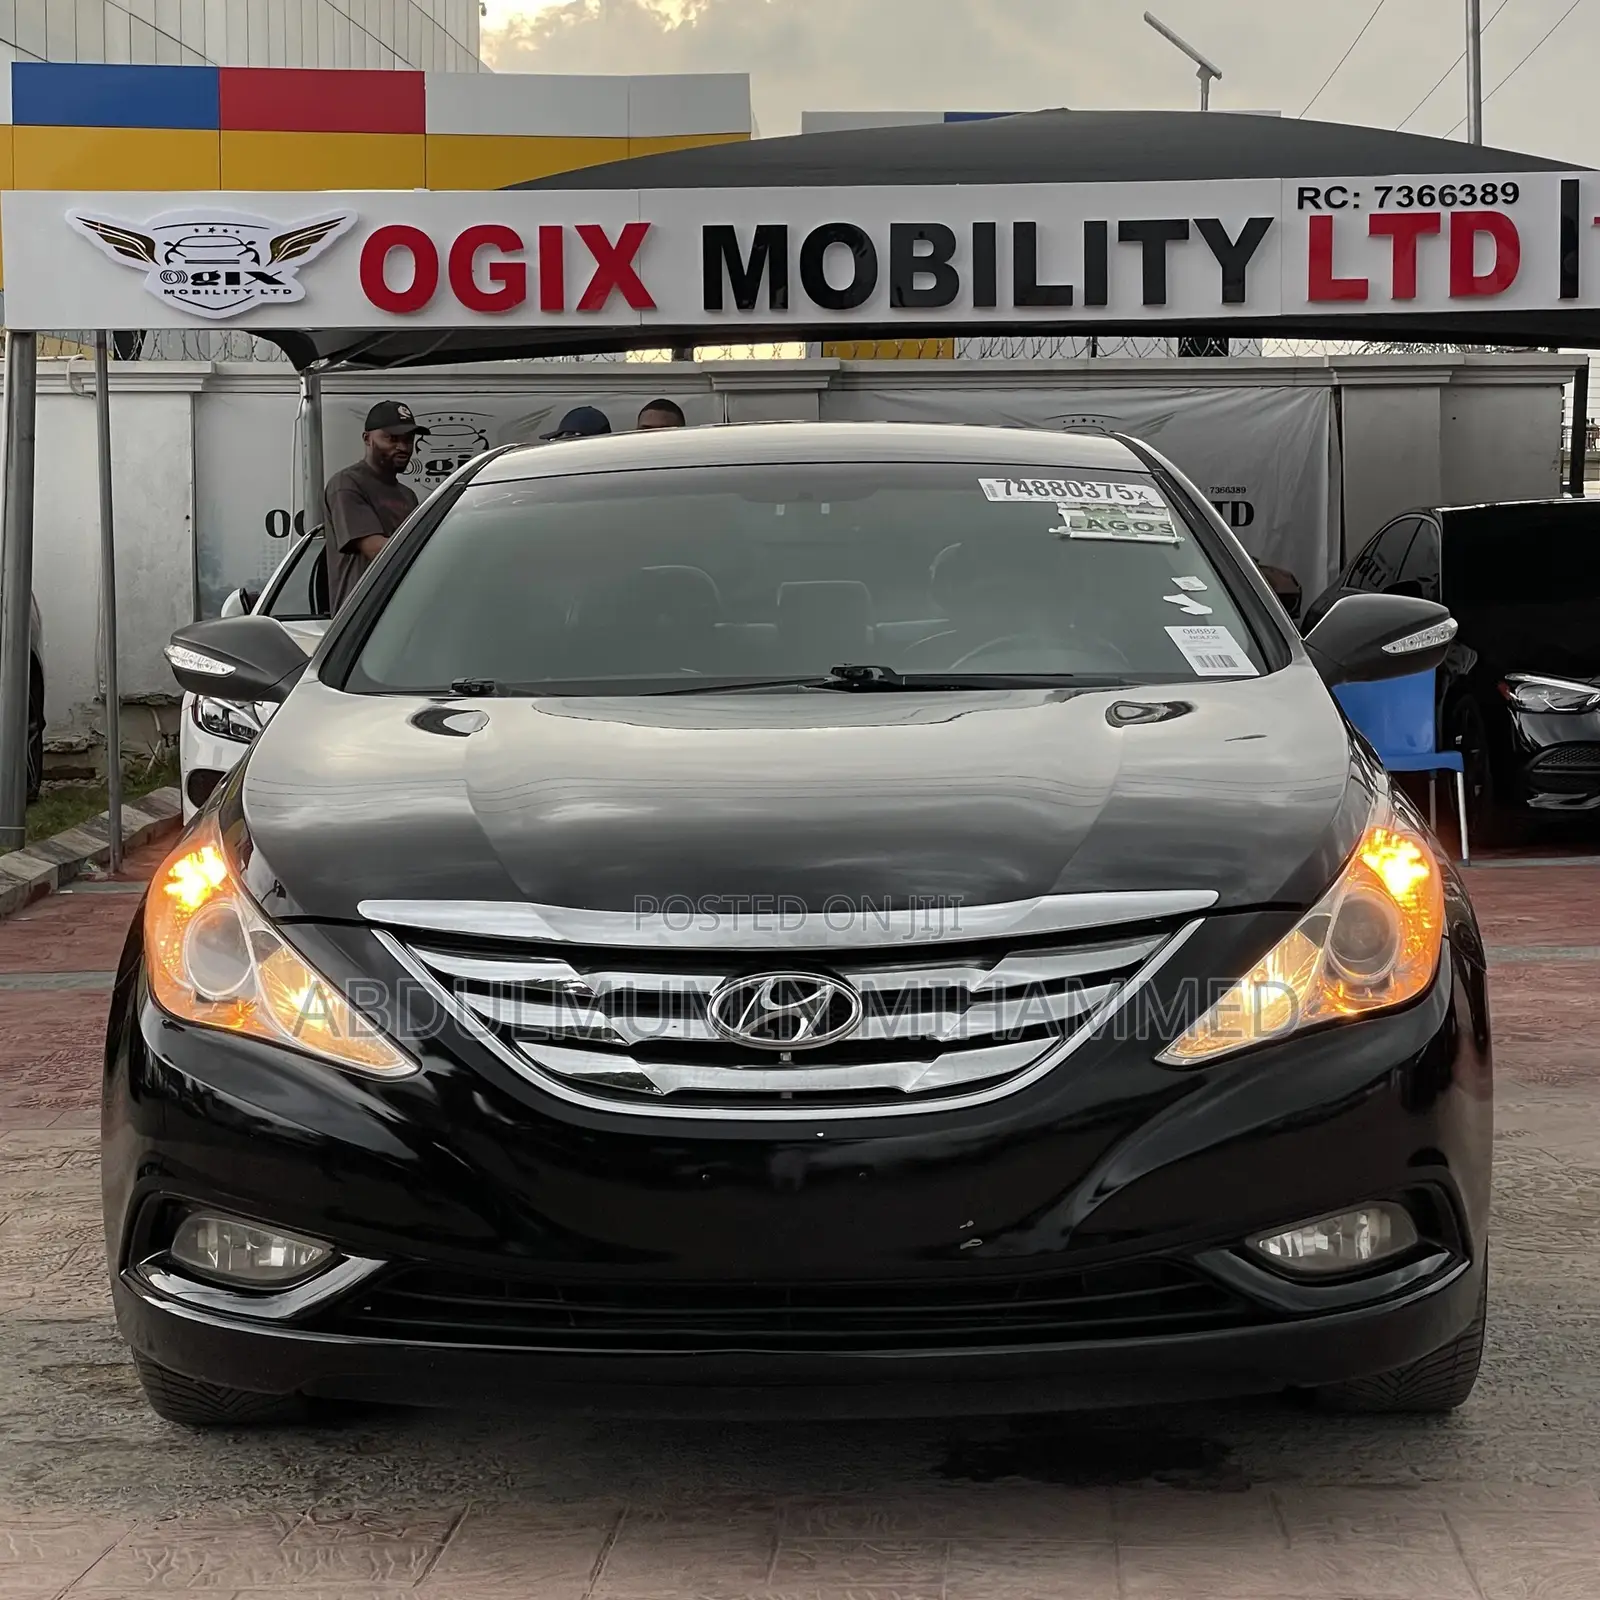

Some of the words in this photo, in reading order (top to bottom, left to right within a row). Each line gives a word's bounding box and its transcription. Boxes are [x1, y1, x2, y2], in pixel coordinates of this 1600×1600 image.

[1297, 185, 1360, 210] RC:
[1374, 181, 1520, 208] 7366389
[359, 222, 657, 313] OGIX
[702, 216, 1275, 312] MOBILITY
[1308, 210, 1521, 302] LTD
